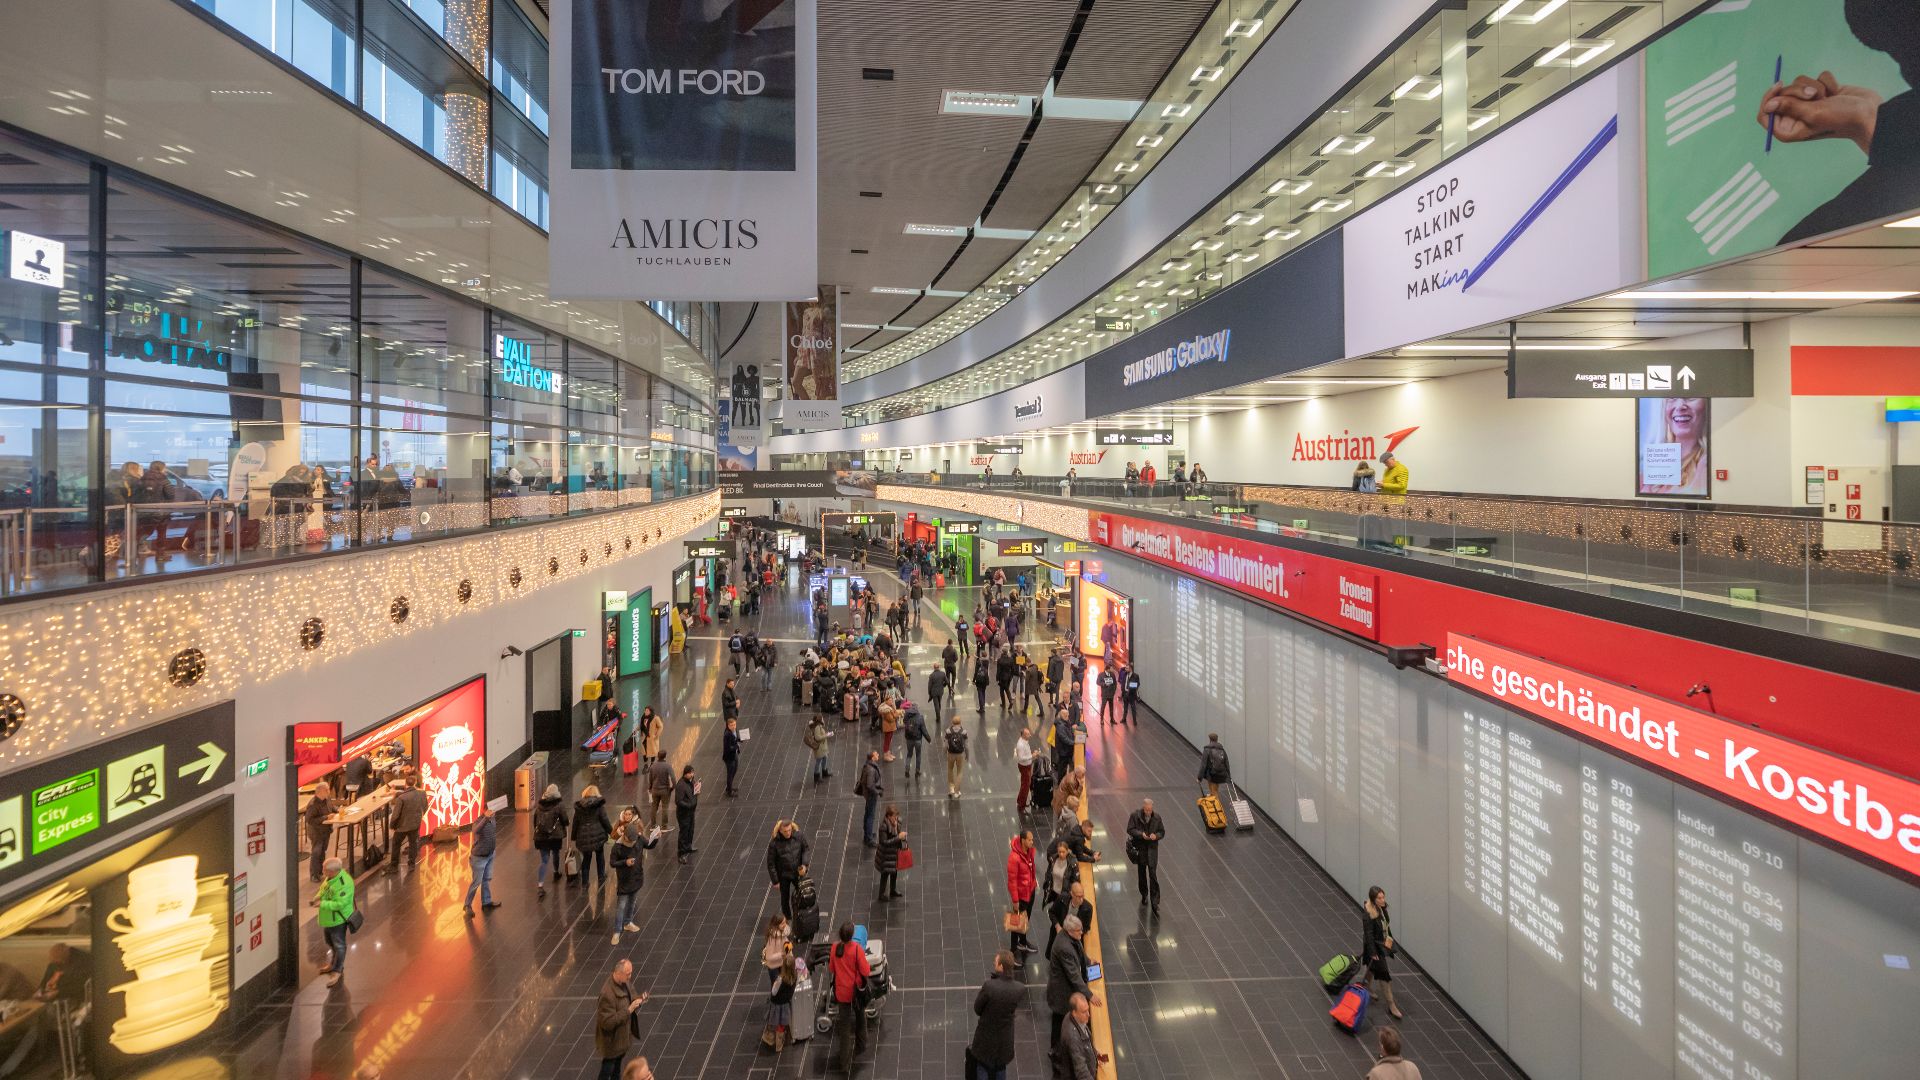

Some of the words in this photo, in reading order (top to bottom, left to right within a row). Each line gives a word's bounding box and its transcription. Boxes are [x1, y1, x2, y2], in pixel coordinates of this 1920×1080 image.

[602, 68, 670, 94] TOM
[679, 69, 765, 95] FORD
[1417, 178, 1459, 213] STOP
[611, 218, 758, 250] AMICIS
[1405, 200, 1475, 246] TALKING
[636, 257, 731, 266] TUCHLAUBEN
[1415, 234, 1464, 269] START
[790, 335, 833, 349] Chloé
[1124, 347, 1174, 386] SAMSUNG
[1177, 329, 1230, 368] Galaxy
[503, 360, 552, 392] DATION
[1575, 373, 1607, 382] Ausgang
[1592, 381, 1607, 389] Exit
[1015, 400, 1037, 418] Terminal
[1037, 395, 1042, 413] 3
[1069, 449, 1097, 465] Austrian
[1292, 429, 1377, 461] Austrian
[1122, 524, 1134, 548] Gut
[1175, 536, 1215, 573] Bestens
[1218, 546, 1288, 598] informiert.
[1340, 576, 1372, 604] Kronen
[1340, 598, 1372, 628] Zeitung
[1087, 597, 1101, 649] change
[1447, 647, 1485, 680] che
[1492, 663, 1680, 758] geschändet
[303, 736, 328, 744] ANKER
[1508, 731, 1532, 750] GRAZ
[1582, 766, 1597, 780] OS
[1678, 809, 1715, 837] landed
[38, 804, 68, 826] City
[38, 812, 94, 842] Express
[1508, 745, 1542, 769] ZAGREB
[1583, 782, 1597, 797] OS
[1678, 831, 1750, 877] approaching
[1509, 760, 1562, 795] NUREMBERG
[1583, 797, 1599, 813] EW
[1678, 849, 1733, 885] expected
[1509, 774, 1542, 799] MUNICH
[1583, 814, 1597, 829] OS
[1678, 867, 1733, 905] expected
[1509, 788, 1540, 813] LEIPZIG
[1583, 830, 1597, 845] OS
[1678, 886, 1750, 936] approaching
[1509, 802, 1552, 834] ISTANBUL
[1583, 845, 1597, 862] PC
[1678, 904, 1733, 944] expected
[1509, 830, 1552, 866] HANOVER
[1583, 877, 1599, 893] EW
[1678, 940, 1733, 983] expected
[1509, 872, 1536, 898] MILAN
[1540, 894, 1560, 914] MXP
[1584, 926, 1598, 943] OS
[1509, 844, 1548, 878] HELSINKI
[1584, 894, 1598, 909] AY
[1678, 959, 1733, 1002] expected
[1583, 862, 1597, 878] OE
[1678, 922, 1733, 963] expected
[1509, 886, 1564, 934] BARCELONA
[1584, 941, 1598, 958] VY
[1678, 1013, 1733, 1061] expected
[1510, 915, 1564, 963] FRANKFURT
[1584, 972, 1597, 991] LH
[1584, 909, 1600, 928] W6
[1678, 977, 1733, 1021] expected
[1584, 956, 1597, 973] FV
[1678, 1032, 1733, 1080] expected
